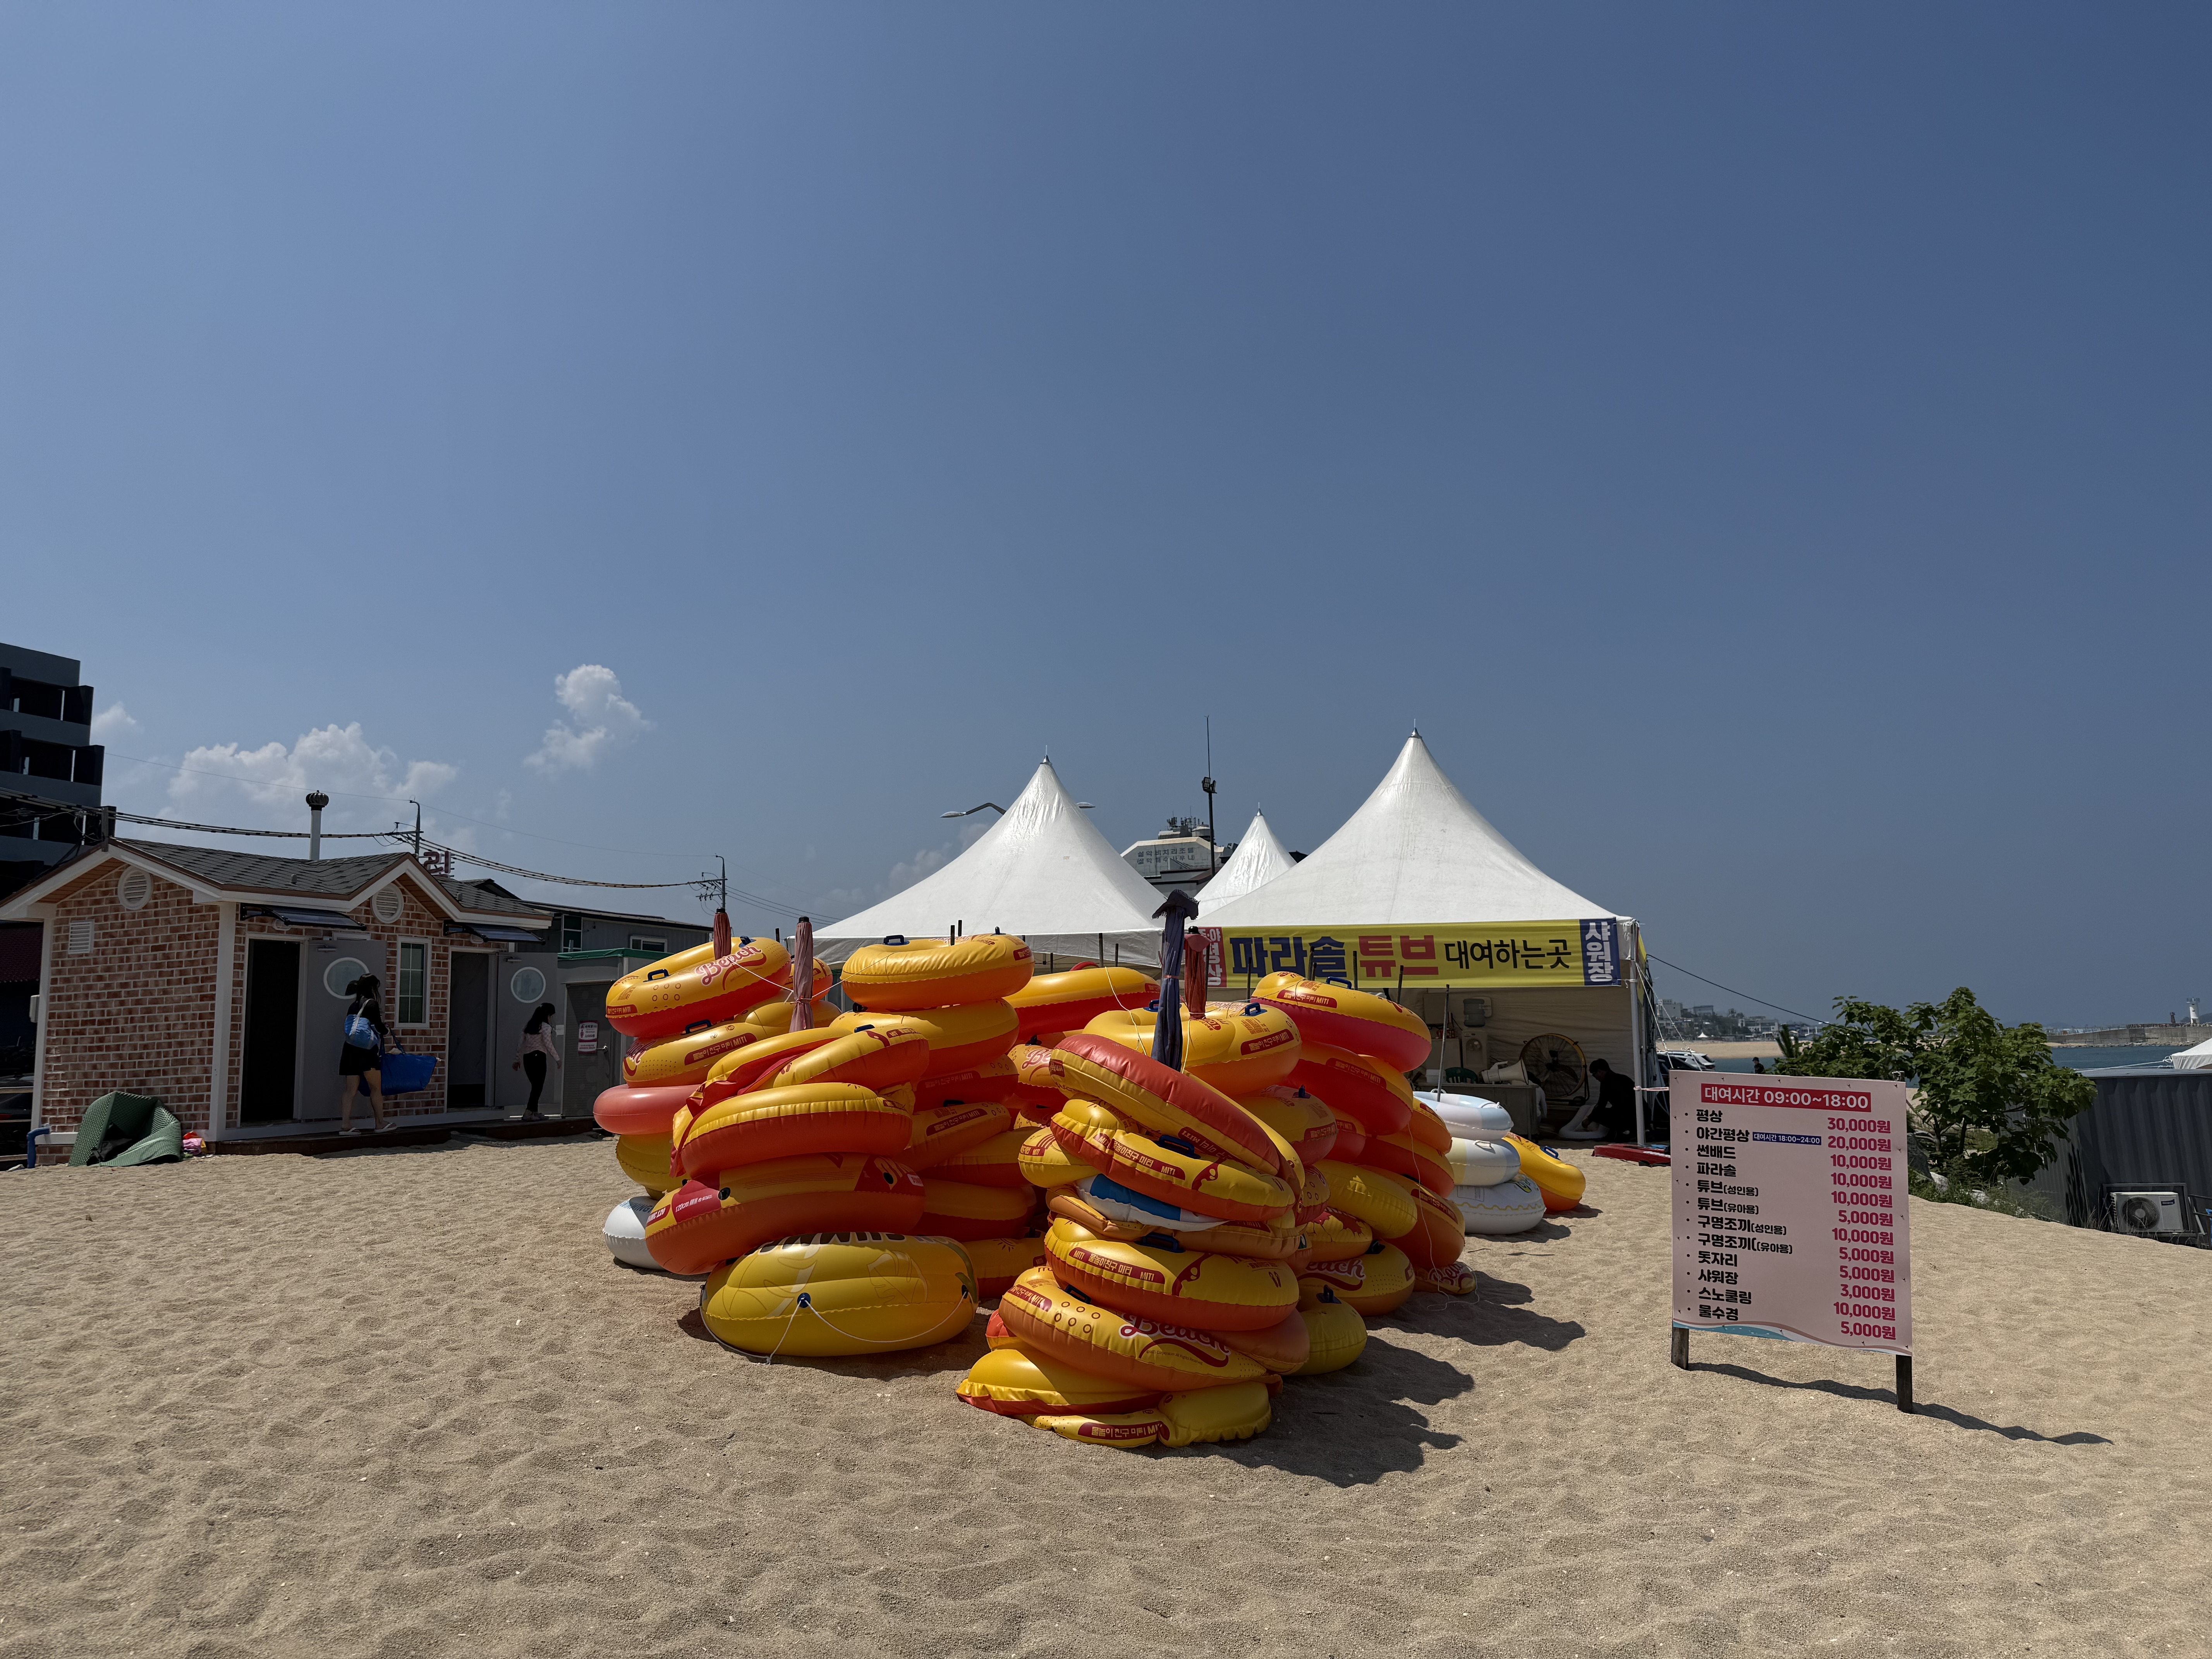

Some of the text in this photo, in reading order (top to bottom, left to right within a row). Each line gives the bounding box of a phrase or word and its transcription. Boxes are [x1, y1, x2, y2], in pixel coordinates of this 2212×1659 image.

[696, 946, 762, 985] Beach
[1230, 935, 1571, 978] 파라솔 튜브 대여하는곳
[1586, 921, 1613, 982] 샤워장
[733, 1036, 747, 1046] MITI
[1705, 1087, 1869, 1109] 대여시간 09:00~18:00
[1696, 1109, 1891, 1133] 평상 30,000원
[1181, 1130, 1200, 1144] MITI
[1697, 1127, 1891, 1152] 야간평상 대여시간 18:00~24:00 20,000원
[1139, 1155, 1154, 1168] 미티
[1161, 1164, 1176, 1176] MITI
[1696, 1144, 1892, 1171] 썬배드 10,000원
[1697, 1162, 1892, 1190] 파라솔 10,000원
[1697, 1180, 1893, 1208] 튜브(성인용) 10,000원
[1697, 1197, 1893, 1227] 튜브(유아용) 5,000원
[1697, 1215, 1894, 1246] 구명조끼(성인용) 10,000원
[1073, 1250, 1085, 1260] MITI
[1118, 1264, 1133, 1276] 미티
[1140, 1271, 1155, 1281] MITI
[1698, 1250, 1894, 1283] 돗자리 5,000원
[1839, 1247, 1894, 1264] 5,000원
[1698, 1269, 1895, 1302] 샤워장 3,000원
[1698, 1287, 1896, 1321] 스노쿨링 10,000원
[1698, 1304, 1896, 1340] 물수경 5,000원
[1115, 1429, 1130, 1437] 친구
[1131, 1427, 1146, 1437] 미티
